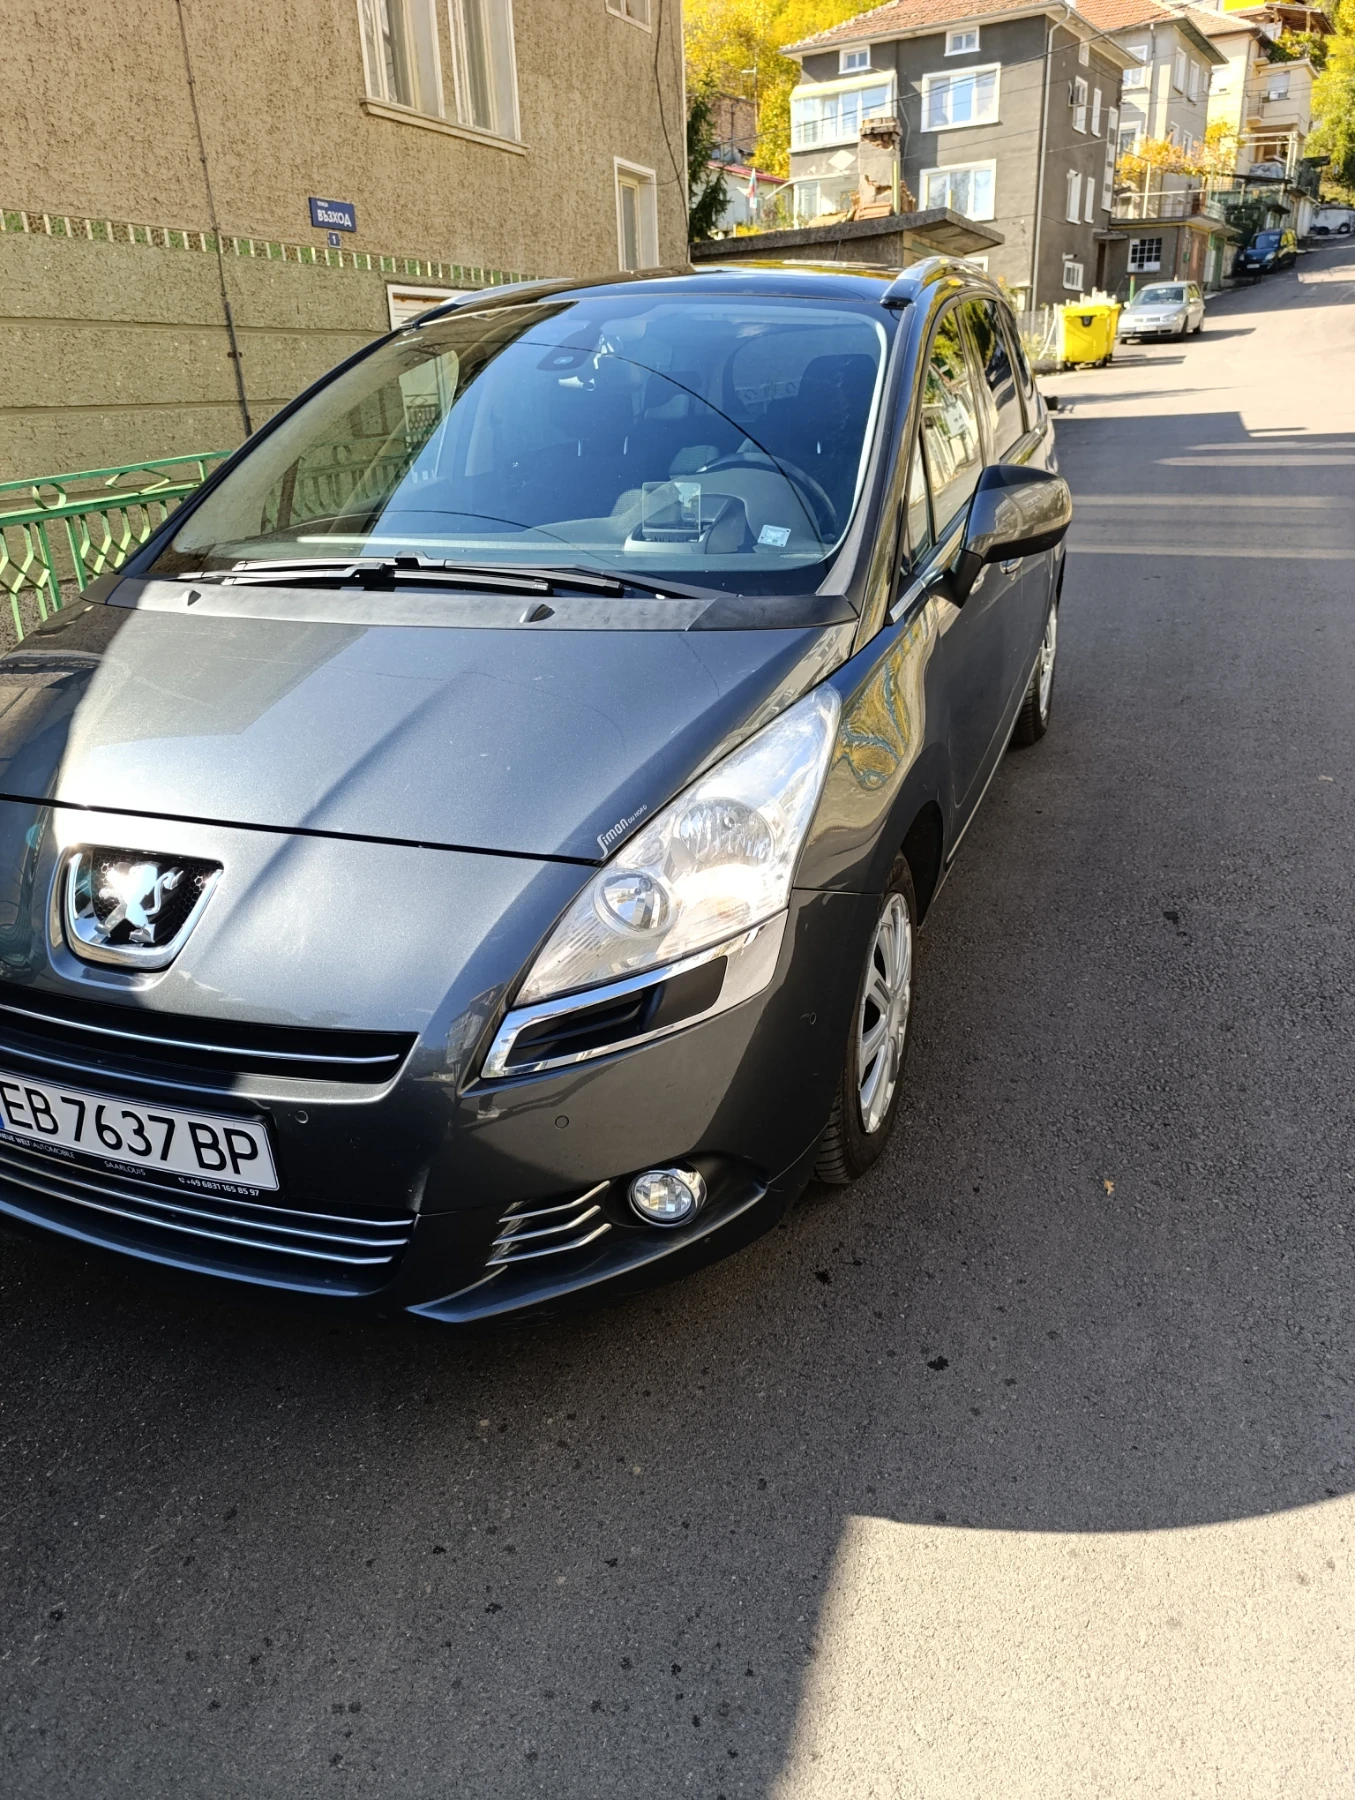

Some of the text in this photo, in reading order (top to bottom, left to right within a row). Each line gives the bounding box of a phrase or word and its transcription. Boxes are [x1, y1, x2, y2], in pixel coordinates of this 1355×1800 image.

[317, 210, 352, 227] ВЪЗХОД
[332, 235, 337, 244] 1
[104, 1160, 146, 1176] SAARLOUIS
[186, 1179, 260, 1197] +49 6831 165 85 97
